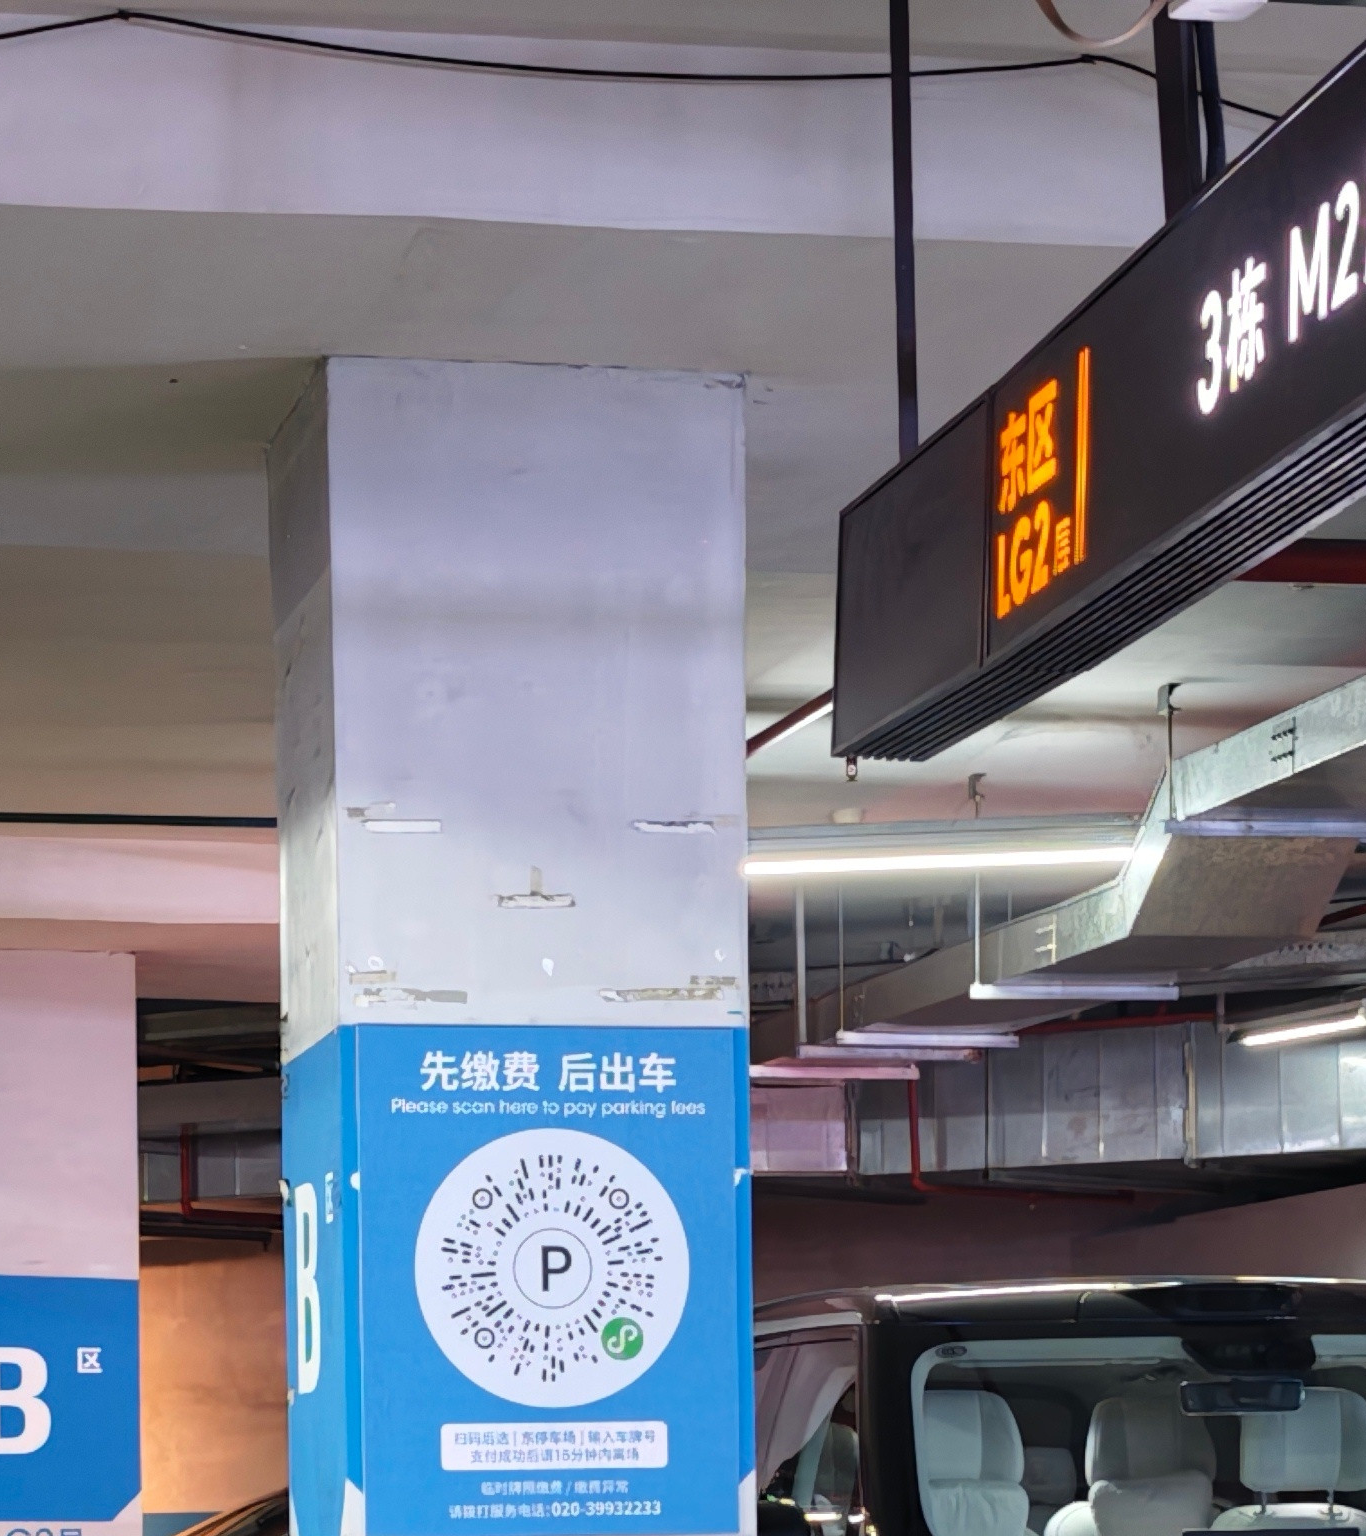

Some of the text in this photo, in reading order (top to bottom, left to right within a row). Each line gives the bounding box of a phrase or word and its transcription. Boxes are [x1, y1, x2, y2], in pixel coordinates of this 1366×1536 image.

[1196, 256, 1267, 417] 3栋
[997, 379, 1062, 515] 东区
[995, 501, 1073, 621] LG2层
[391, 1097, 707, 1119] Please scan here to pay parking fees
[420, 1051, 678, 1094] 先缴费 后出车
[295, 1182, 322, 1395] B
[541, 1245, 573, 1292] P
[76, 1347, 103, 1374] 区
